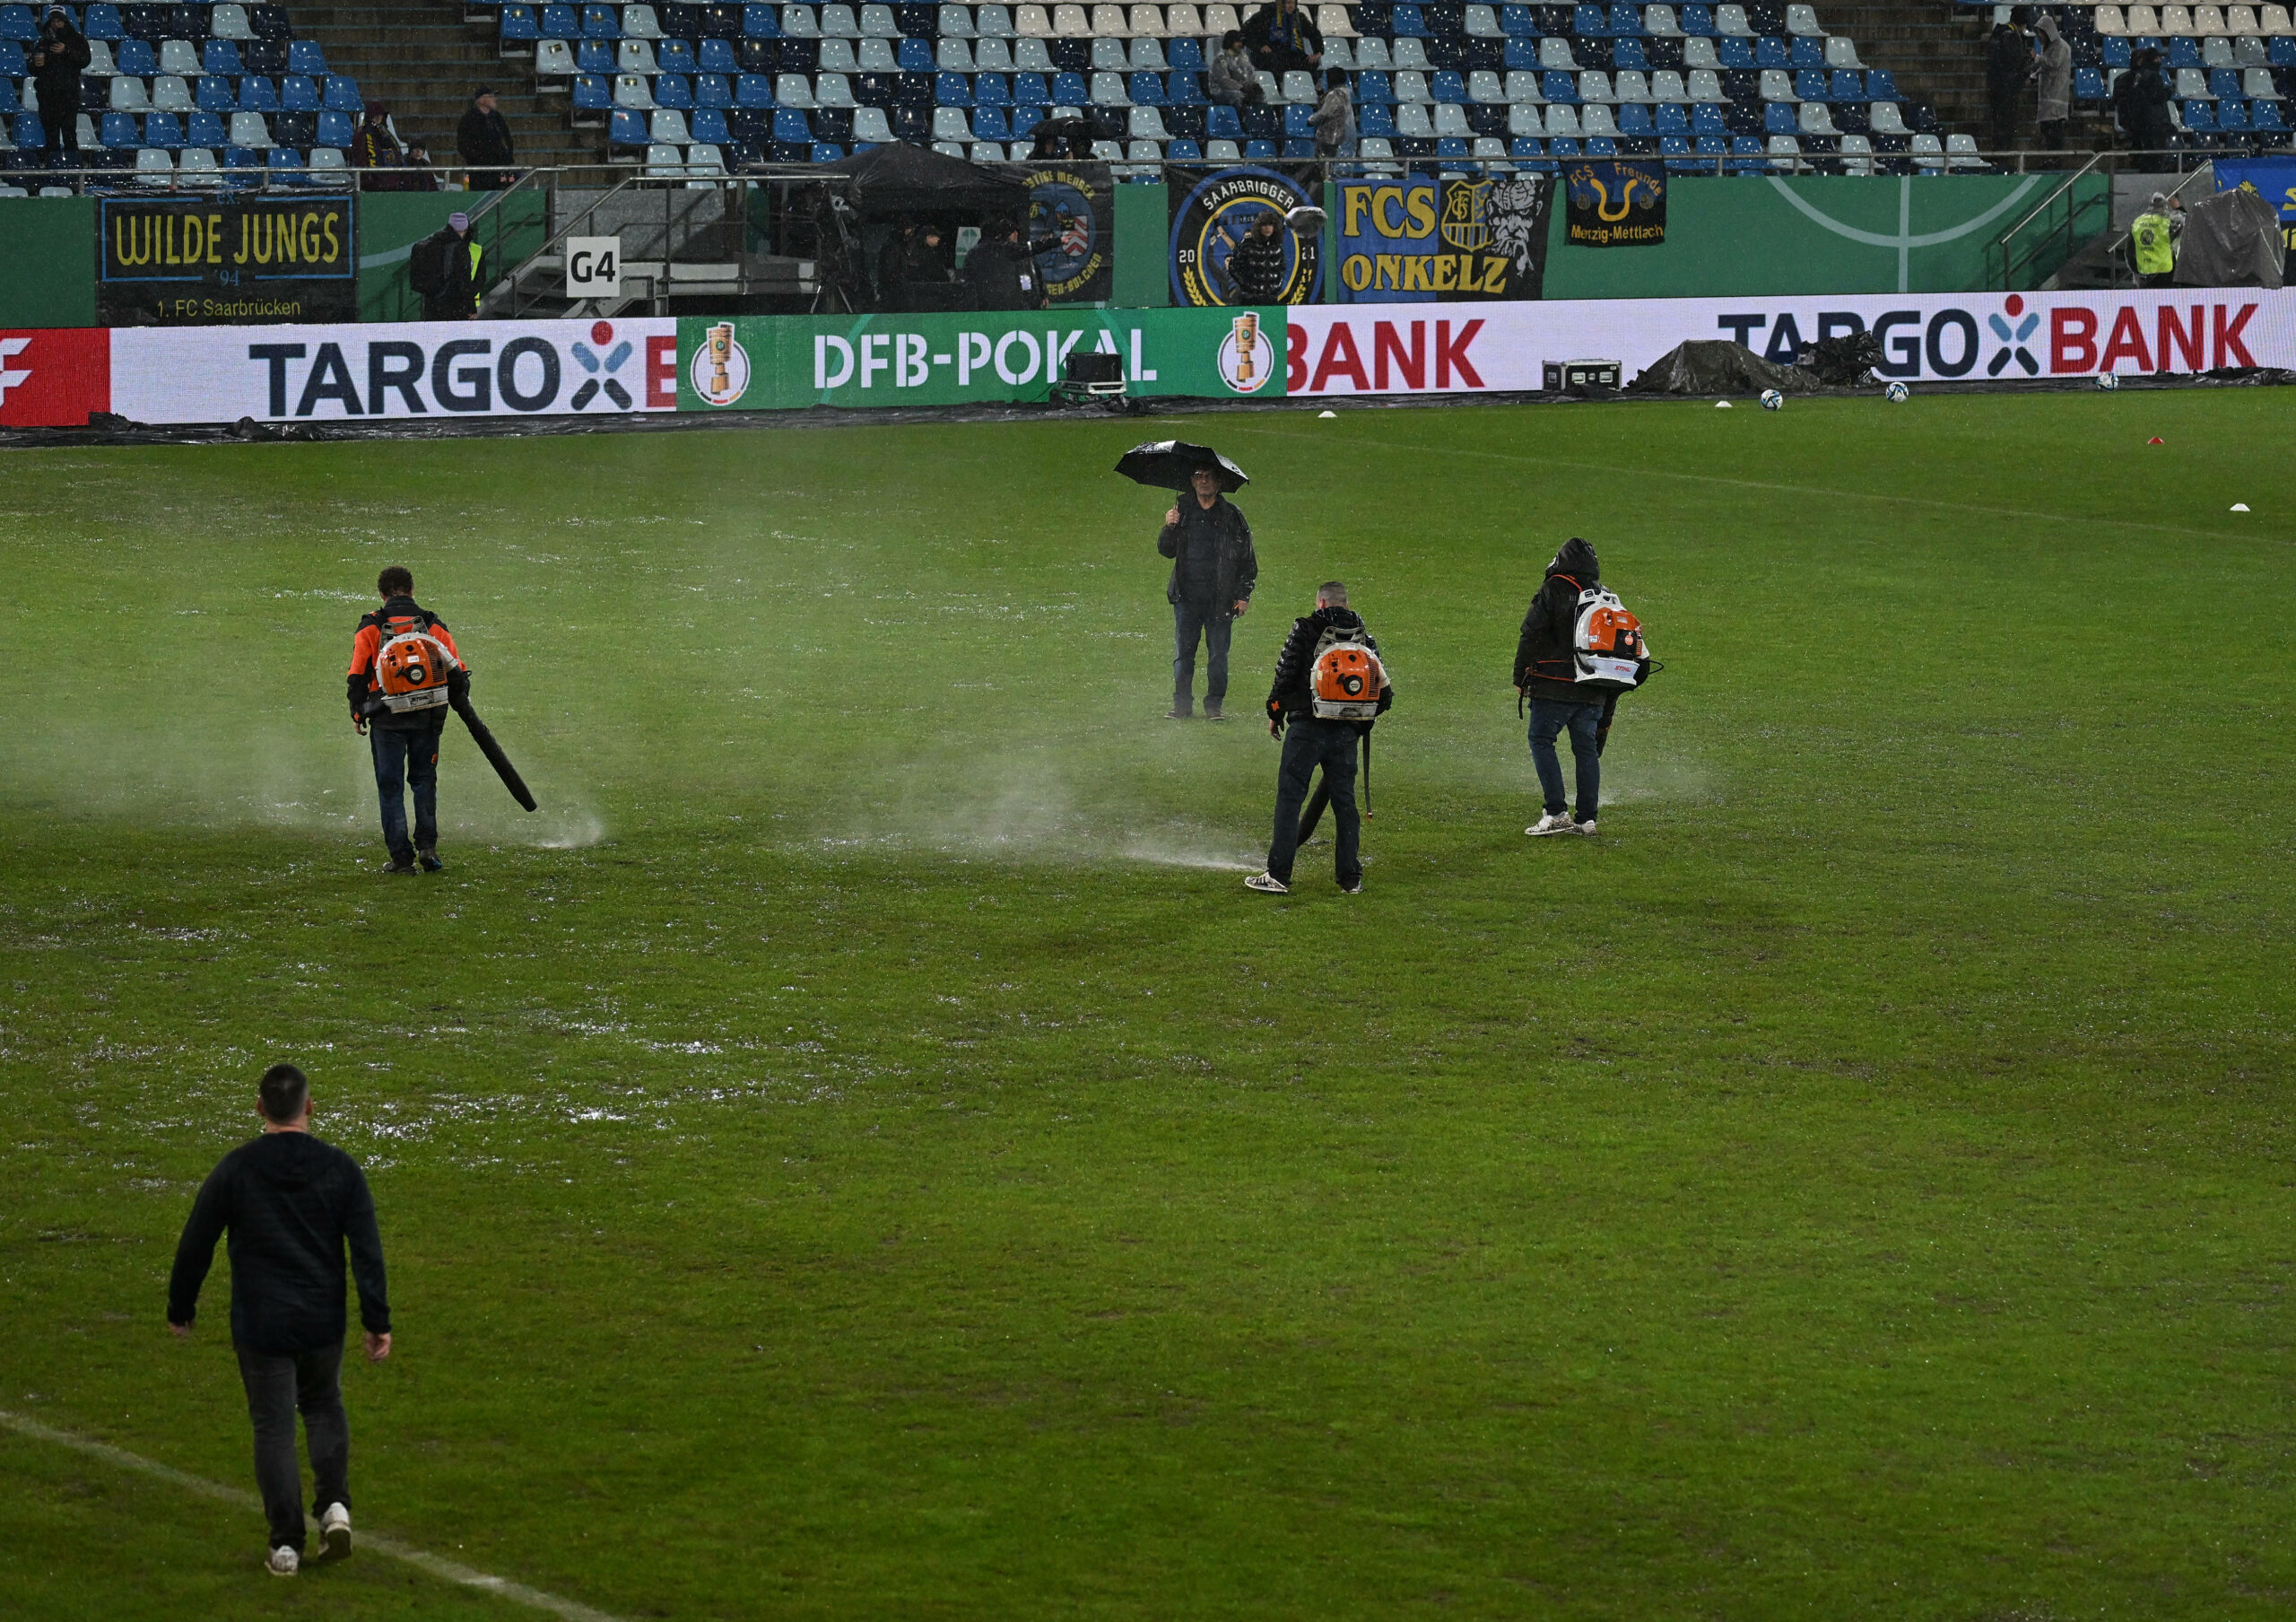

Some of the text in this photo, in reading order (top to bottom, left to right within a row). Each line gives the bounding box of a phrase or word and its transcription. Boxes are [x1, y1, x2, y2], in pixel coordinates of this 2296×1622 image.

[1203, 180, 1295, 211] SAARBRIGGER
[1570, 162, 1663, 196] FCS Freunde
[1343, 185, 1435, 239] FCS
[116, 212, 339, 266] WILDE JUNGS
[1571, 223, 1664, 244] Merzig-Mettlach
[570, 250, 616, 283] G4
[1342, 254, 1509, 294] ONKELZ
[158, 298, 300, 318] 1. FC Saarbrücken
[2050, 303, 2259, 374] BANK
[248, 336, 561, 417] TARGO
